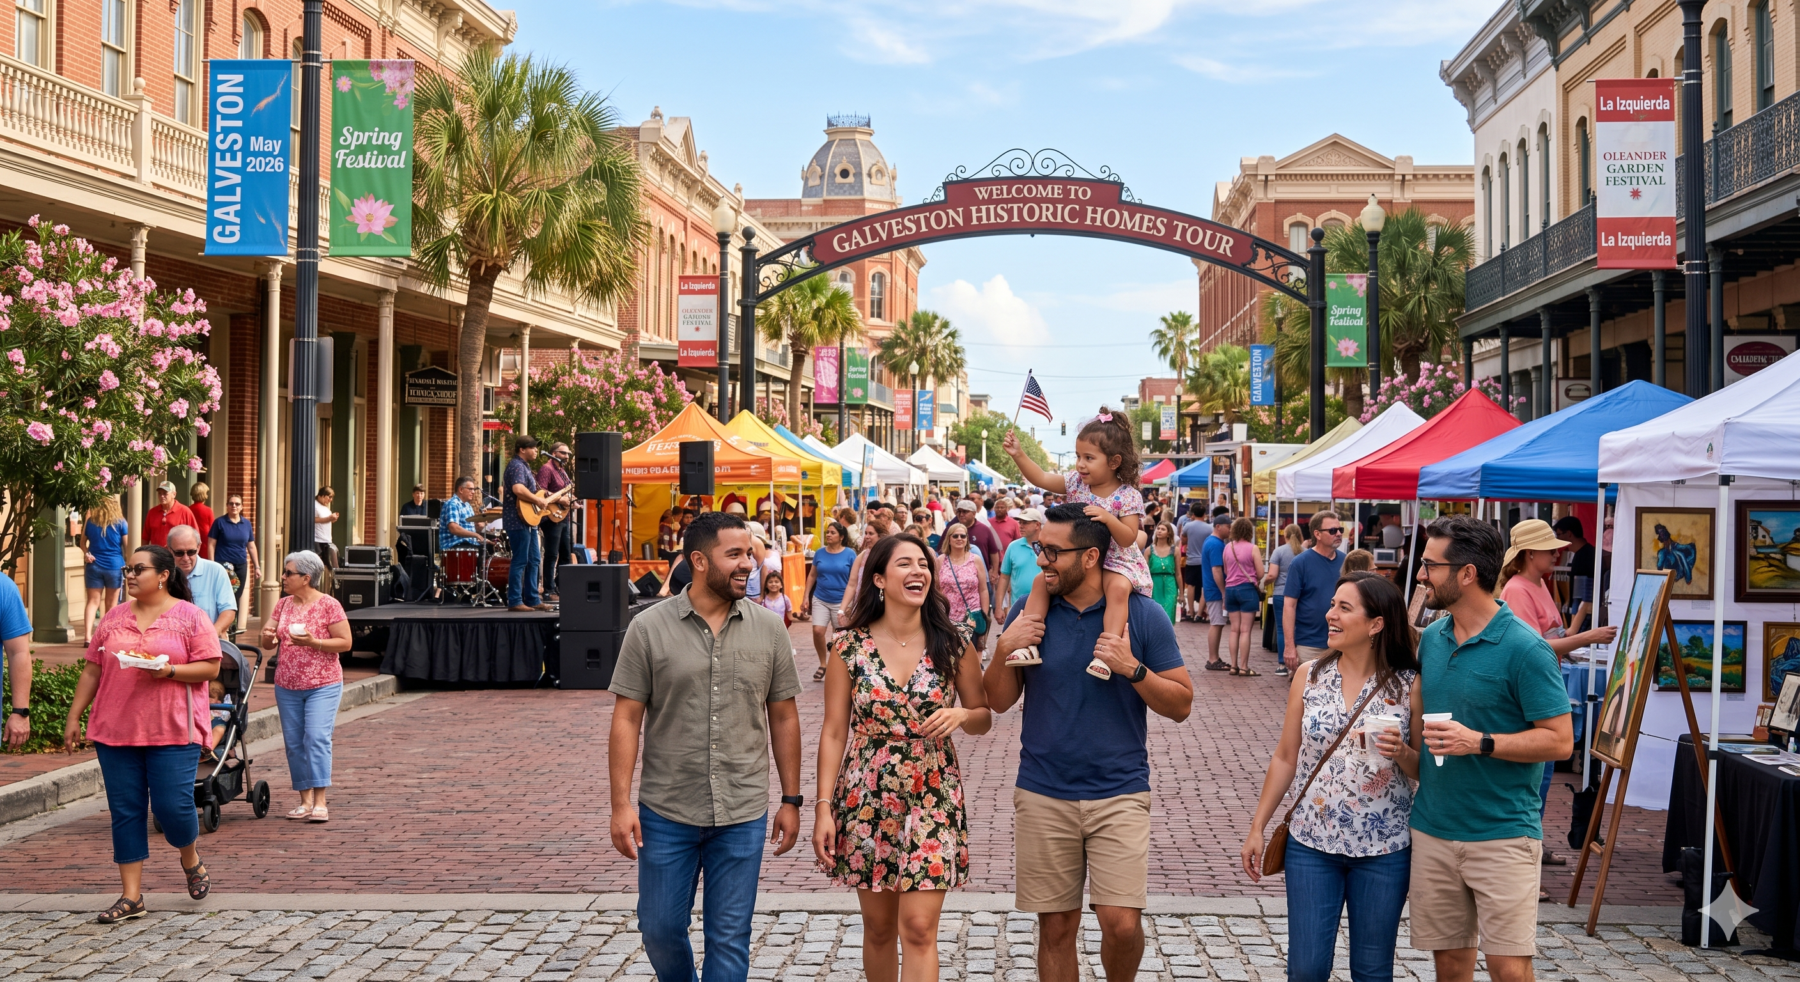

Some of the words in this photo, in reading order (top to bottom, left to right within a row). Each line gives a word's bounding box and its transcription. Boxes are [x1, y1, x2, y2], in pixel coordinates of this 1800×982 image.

[1600, 96, 1614, 111] La
[1616, 95, 1670, 114] Izquierda
[250, 136, 282, 156] May
[339, 126, 403, 151] Spring
[212, 74, 244, 244] GALVESTON
[246, 156, 285, 173] 2026
[335, 150, 406, 169] Festival
[1603, 151, 1667, 161] OLEANDER
[1606, 163, 1664, 174] GARDEN
[1605, 175, 1666, 186] FESTIVAL
[973, 184, 1064, 200] WELCOME
[1068, 185, 1092, 200] TO
[832, 207, 965, 254] GALVESTON
[969, 203, 1080, 225] HISTORIC
[1084, 205, 1168, 237] HOMES
[1172, 220, 1235, 258] TOUR
[1601, 231, 1615, 247] La
[1617, 231, 1672, 251] Izquierda
[680, 282, 688, 290] La
[689, 281, 715, 291] Izquierda
[1330, 304, 1362, 317] Spring
[680, 347, 688, 357] La
[688, 347, 715, 358] Izquierda
